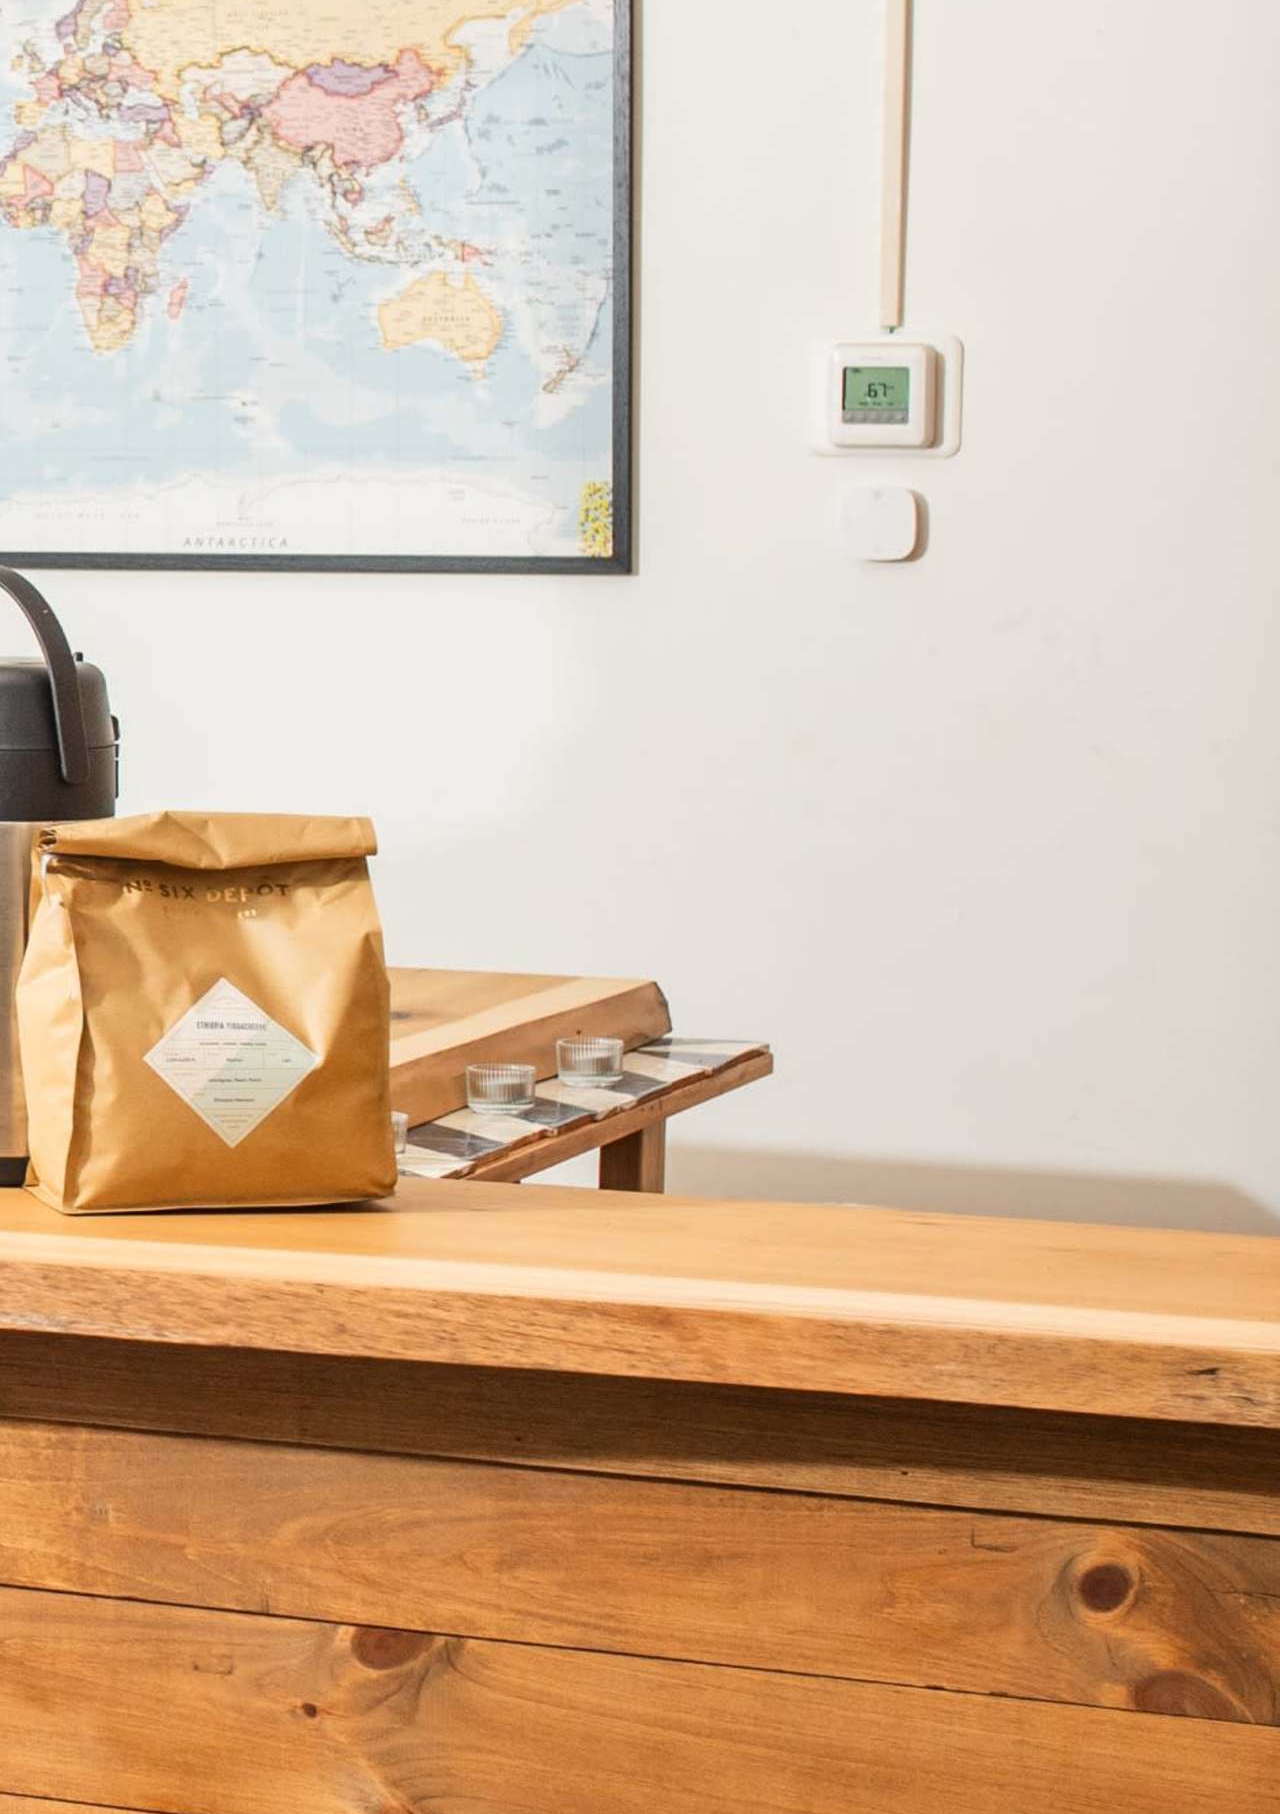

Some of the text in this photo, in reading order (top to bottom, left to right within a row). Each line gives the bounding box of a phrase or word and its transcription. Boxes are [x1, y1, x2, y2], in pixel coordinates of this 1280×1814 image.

[183, 536, 289, 549] ANTARCTICA
[159, 884, 195, 900] SIX
[206, 883, 290, 903] DEPOT
